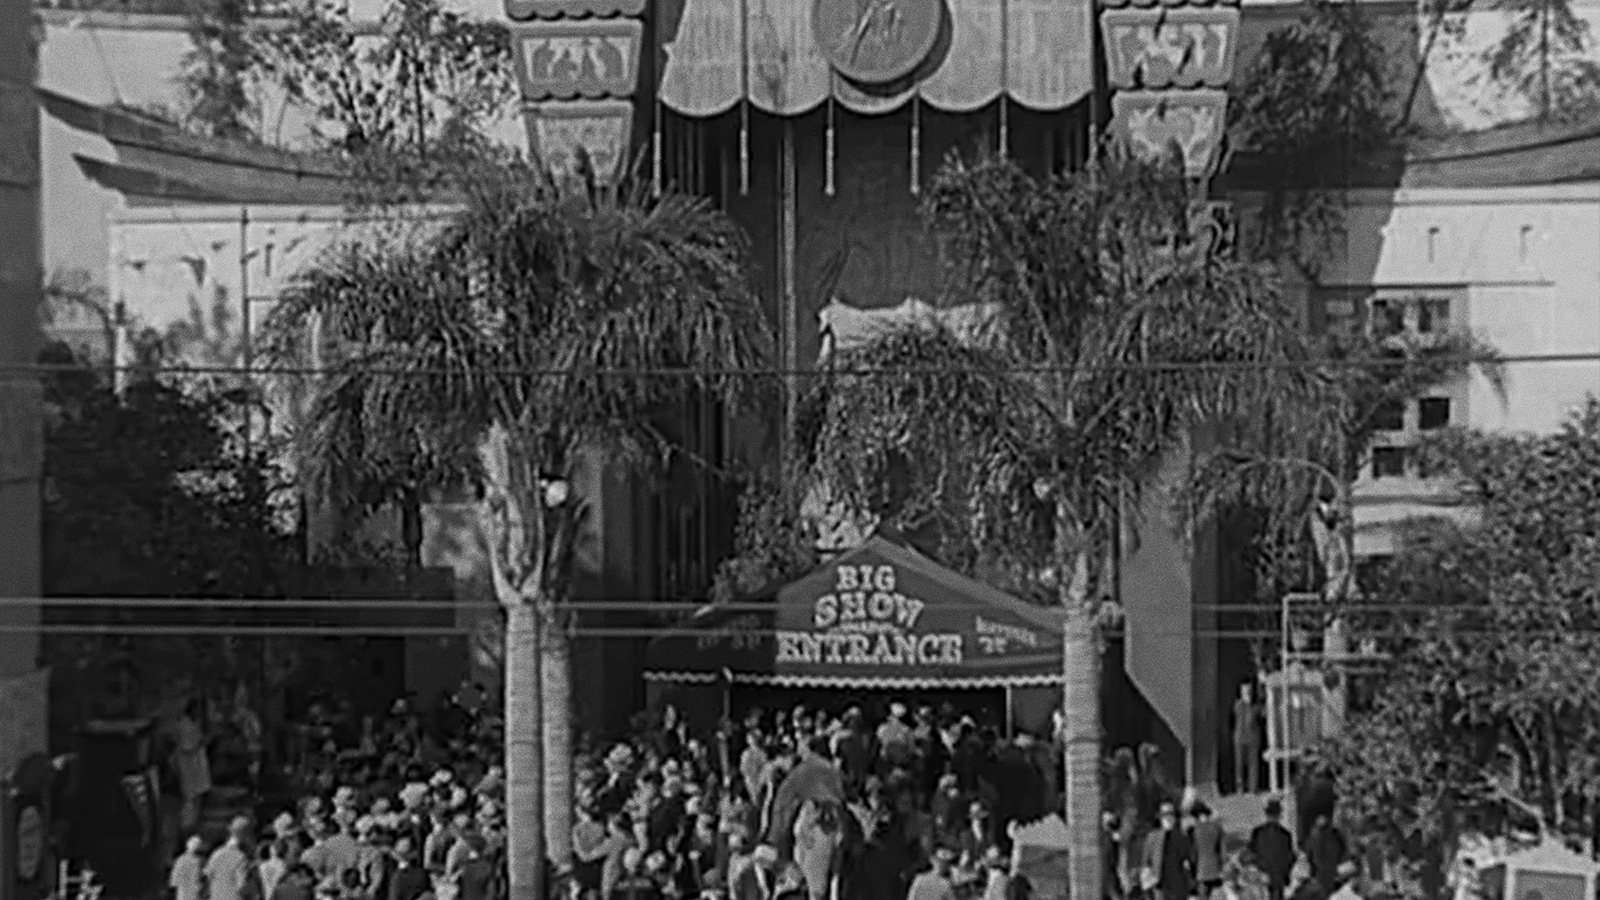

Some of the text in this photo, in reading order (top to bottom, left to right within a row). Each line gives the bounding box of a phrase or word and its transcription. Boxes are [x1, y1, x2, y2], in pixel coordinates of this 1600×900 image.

[836, 565, 895, 591] BIG
[815, 592, 925, 628] SHOW
[775, 631, 962, 665] ENTRANCE
